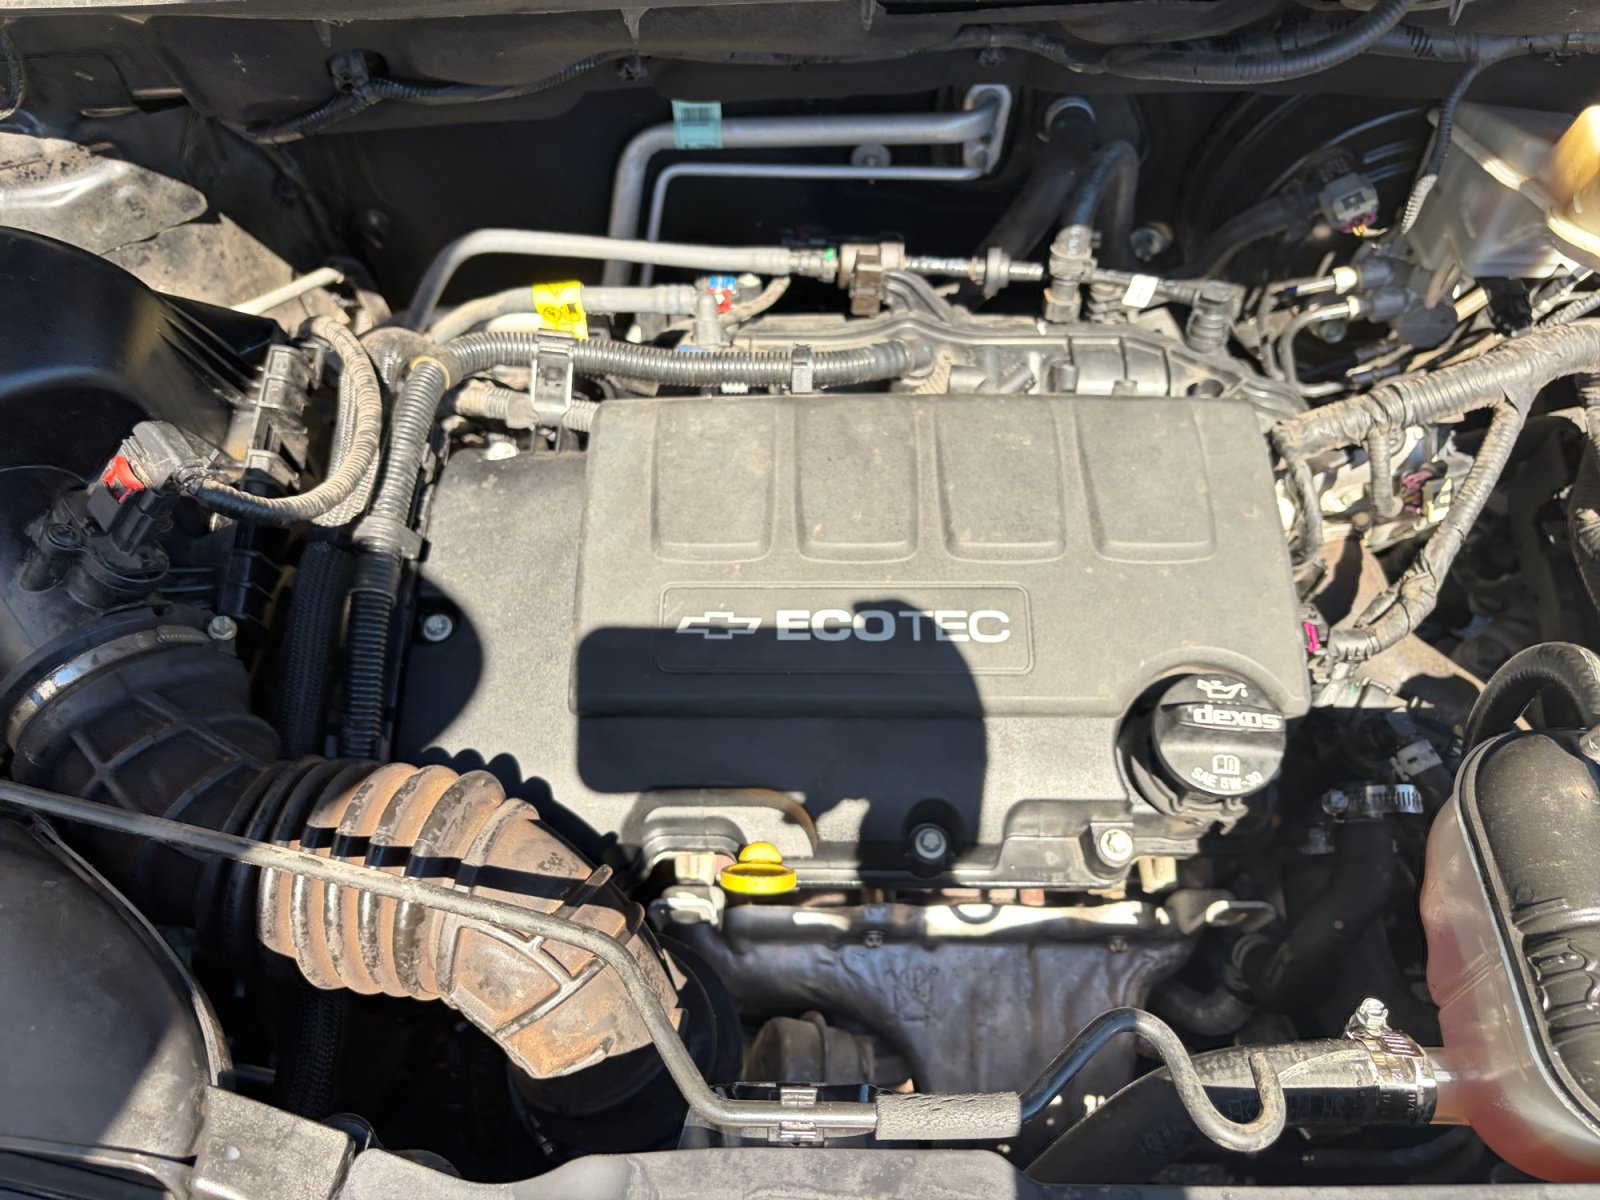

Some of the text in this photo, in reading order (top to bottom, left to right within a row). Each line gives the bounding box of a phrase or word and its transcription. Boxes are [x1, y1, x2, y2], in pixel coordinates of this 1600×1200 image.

[776, 609, 1010, 643] ECOTEC
[1193, 704, 1282, 729] dexos
[1191, 767, 1265, 790] SAE 5W-30
